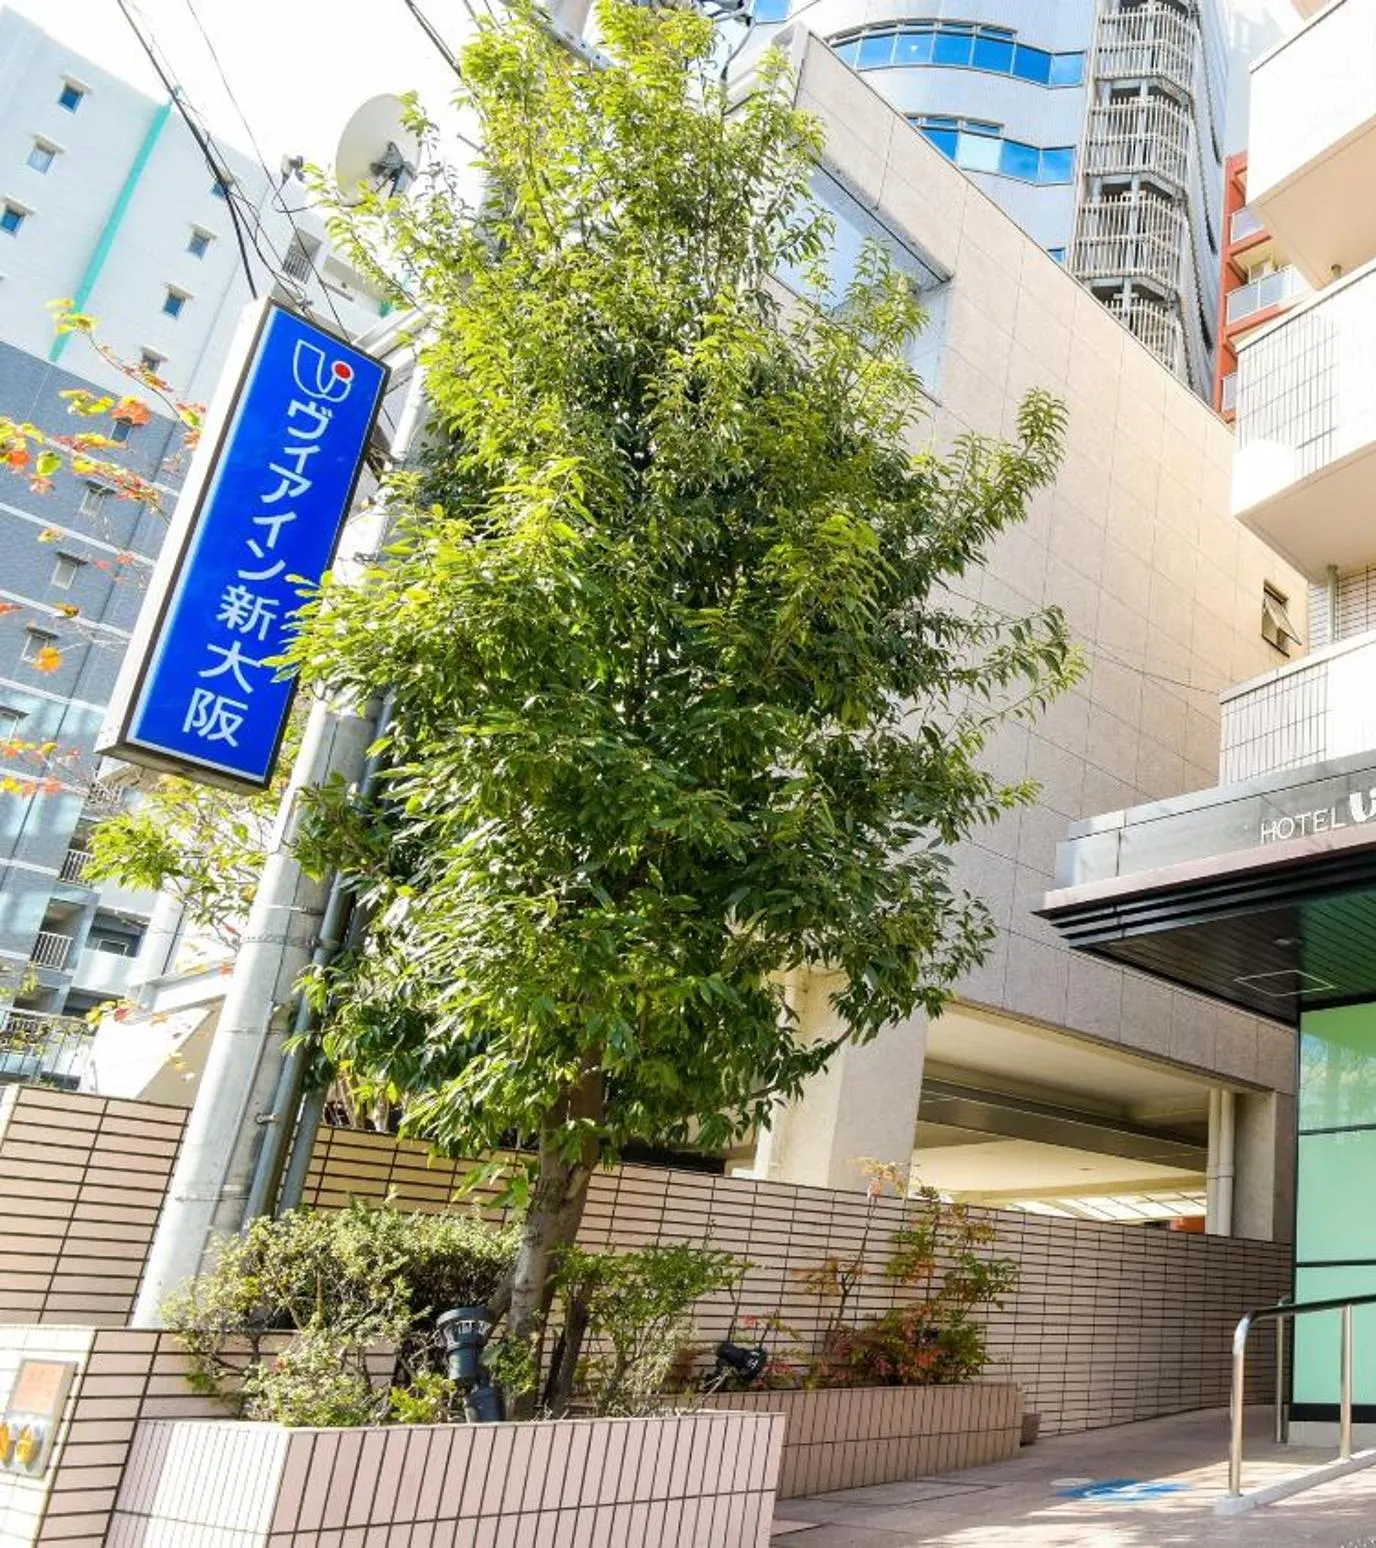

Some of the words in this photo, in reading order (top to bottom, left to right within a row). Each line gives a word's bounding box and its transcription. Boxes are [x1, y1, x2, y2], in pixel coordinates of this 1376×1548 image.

[182, 398, 336, 748] ヴィアイン新大阪
[1260, 806, 1348, 844] HOTEL
